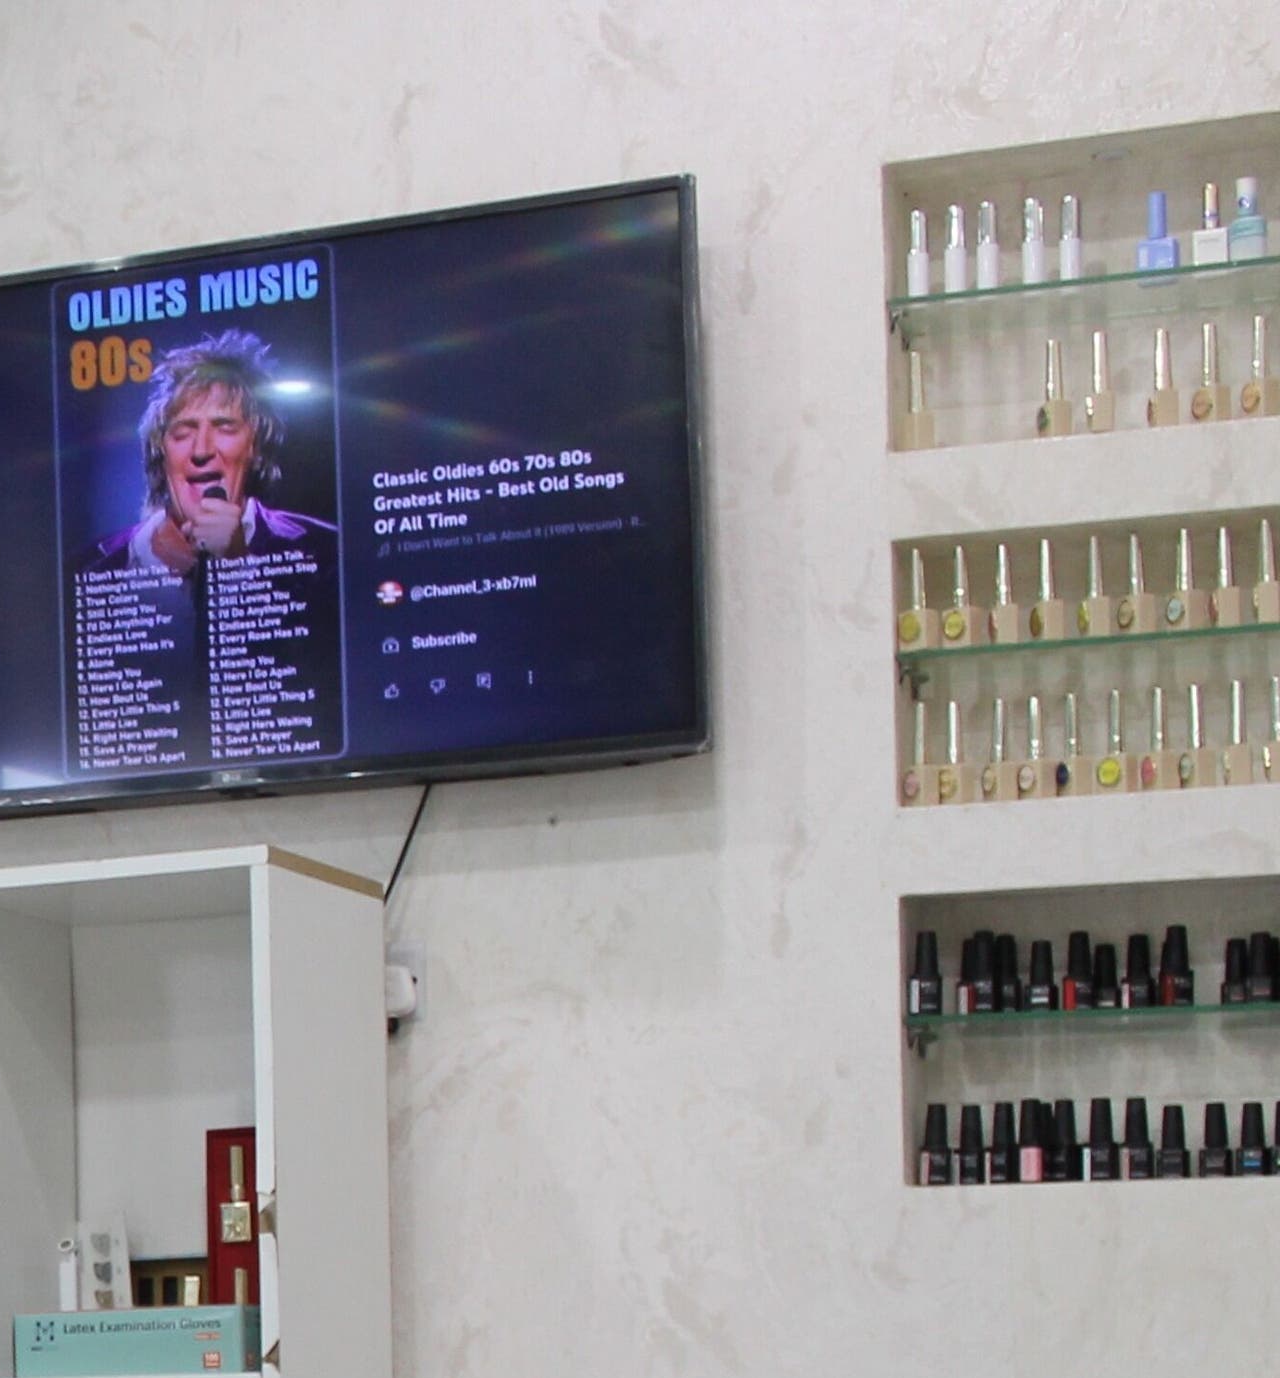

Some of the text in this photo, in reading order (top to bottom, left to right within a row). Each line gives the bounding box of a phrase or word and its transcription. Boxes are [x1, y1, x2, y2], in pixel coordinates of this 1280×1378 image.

[68, 259, 318, 331] OLDIES MUSIC
[374, 450, 592, 488] Classic Oldies 60s 70s 80s
[374, 493, 442, 511] Greatest
[447, 487, 481, 503] Hits
[499, 481, 535, 498] Best
[540, 476, 569, 493] Old
[575, 471, 624, 489] Songs
[400, 515, 422, 531] All
[428, 512, 468, 529] Time
[433, 537, 459, 548] Want
[462, 536, 472, 545] to
[476, 532, 496, 543] Talk
[501, 529, 531, 541] About
[247, 554, 270, 565] Want
[284, 551, 303, 560] Talk
[114, 569, 136, 579] Want
[151, 566, 169, 574] Talk
[295, 563, 317, 573] Stop
[162, 577, 182, 587] Stop
[218, 584, 239, 593] True
[86, 597, 106, 606] True
[219, 596, 238, 606] Still
[240, 594, 271, 604] Loving
[273, 591, 289, 600] You
[87, 605, 156, 618] Still Loving You
[247, 604, 287, 616] Anything
[290, 602, 306, 611] For
[114, 617, 154, 629] Anything
[156, 615, 172, 624] For
[219, 620, 256, 631] Endless
[258, 618, 281, 627] Love
[88, 631, 147, 643] Endless Love
[219, 634, 246, 644] Every
[274, 629, 292, 638] Has
[412, 632, 477, 649] Subscribe
[88, 647, 113, 657] Every
[140, 642, 158, 650] Has
[257, 656, 274, 665] You
[124, 668, 141, 677] You
[224, 672, 246, 681] Here
[270, 666, 296, 678] Again
[92, 684, 114, 693] Here
[136, 679, 162, 690] Again
[222, 684, 243, 694] How
[90, 696, 110, 705] How
[224, 697, 251, 707] Every
[253, 695, 278, 704] Little
[280, 691, 306, 702] Thing
[92, 708, 118, 718] Every
[120, 706, 144, 715] Little
[146, 703, 171, 712] Thing
[225, 710, 249, 719] Little
[251, 708, 271, 717] Lies
[93, 719, 138, 730] Little Lies
[225, 722, 250, 733] Right
[252, 720, 275, 729] Here
[277, 716, 312, 727] Waiting
[93, 728, 178, 744] Right Here Waiting
[226, 736, 248, 744] Save
[260, 731, 291, 742] Prayer
[94, 746, 115, 755] Save
[127, 742, 157, 752] Prayer
[226, 748, 253, 757] Never
[256, 745, 276, 754] Tear
[294, 741, 320, 752] Apart
[93, 758, 120, 767] Never
[122, 755, 142, 765] Tear
[160, 751, 185, 764] Apart
[63, 1317, 222, 1335] Latex Examination Gloves
